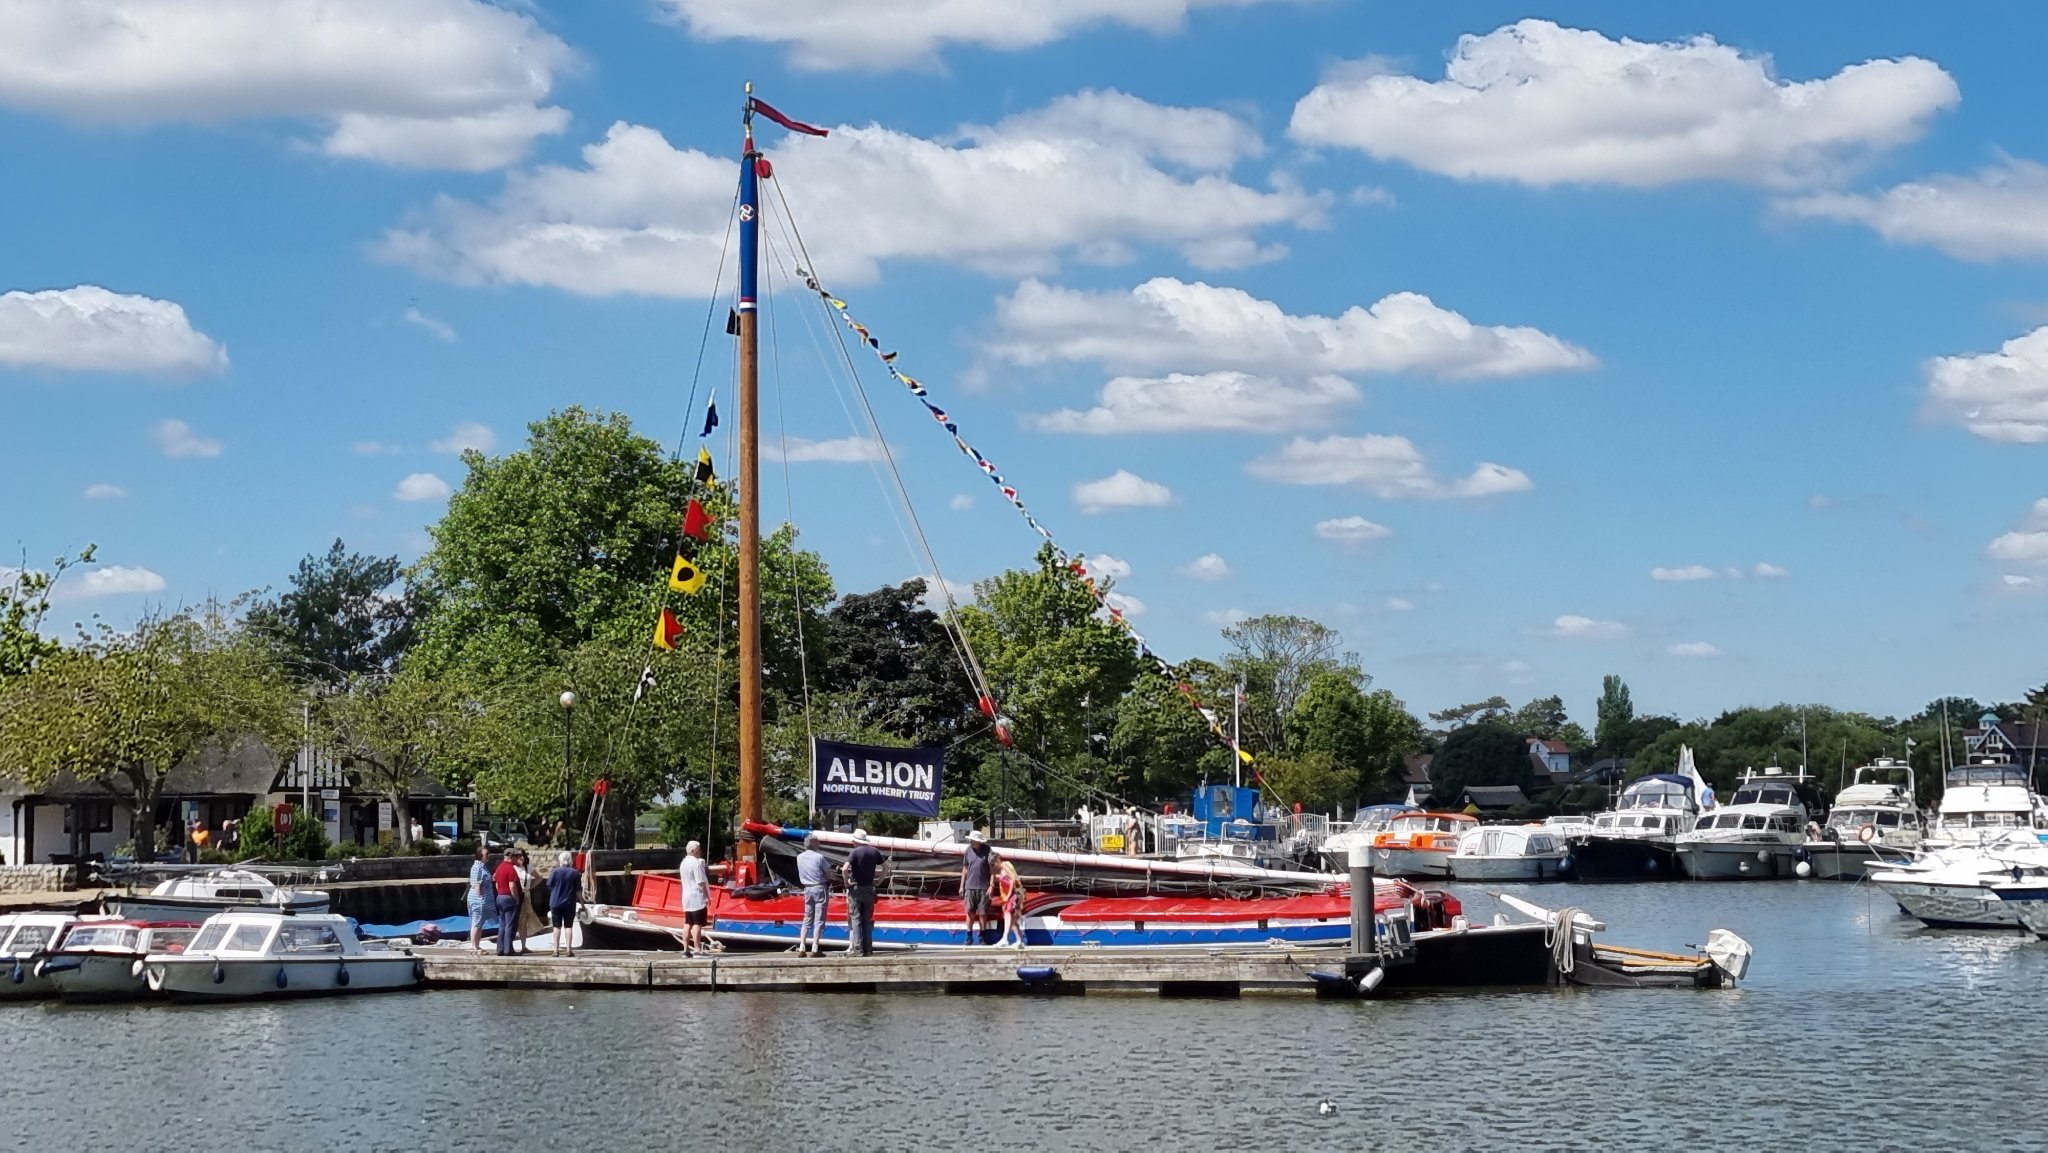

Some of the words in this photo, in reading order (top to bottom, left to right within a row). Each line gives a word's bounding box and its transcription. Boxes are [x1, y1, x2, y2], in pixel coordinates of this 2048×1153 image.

[826, 757, 933, 790] ALBION
[823, 783, 869, 794] NORFOLK
[870, 786, 908, 798] WHERRY
[909, 790, 935, 801] TRUST
